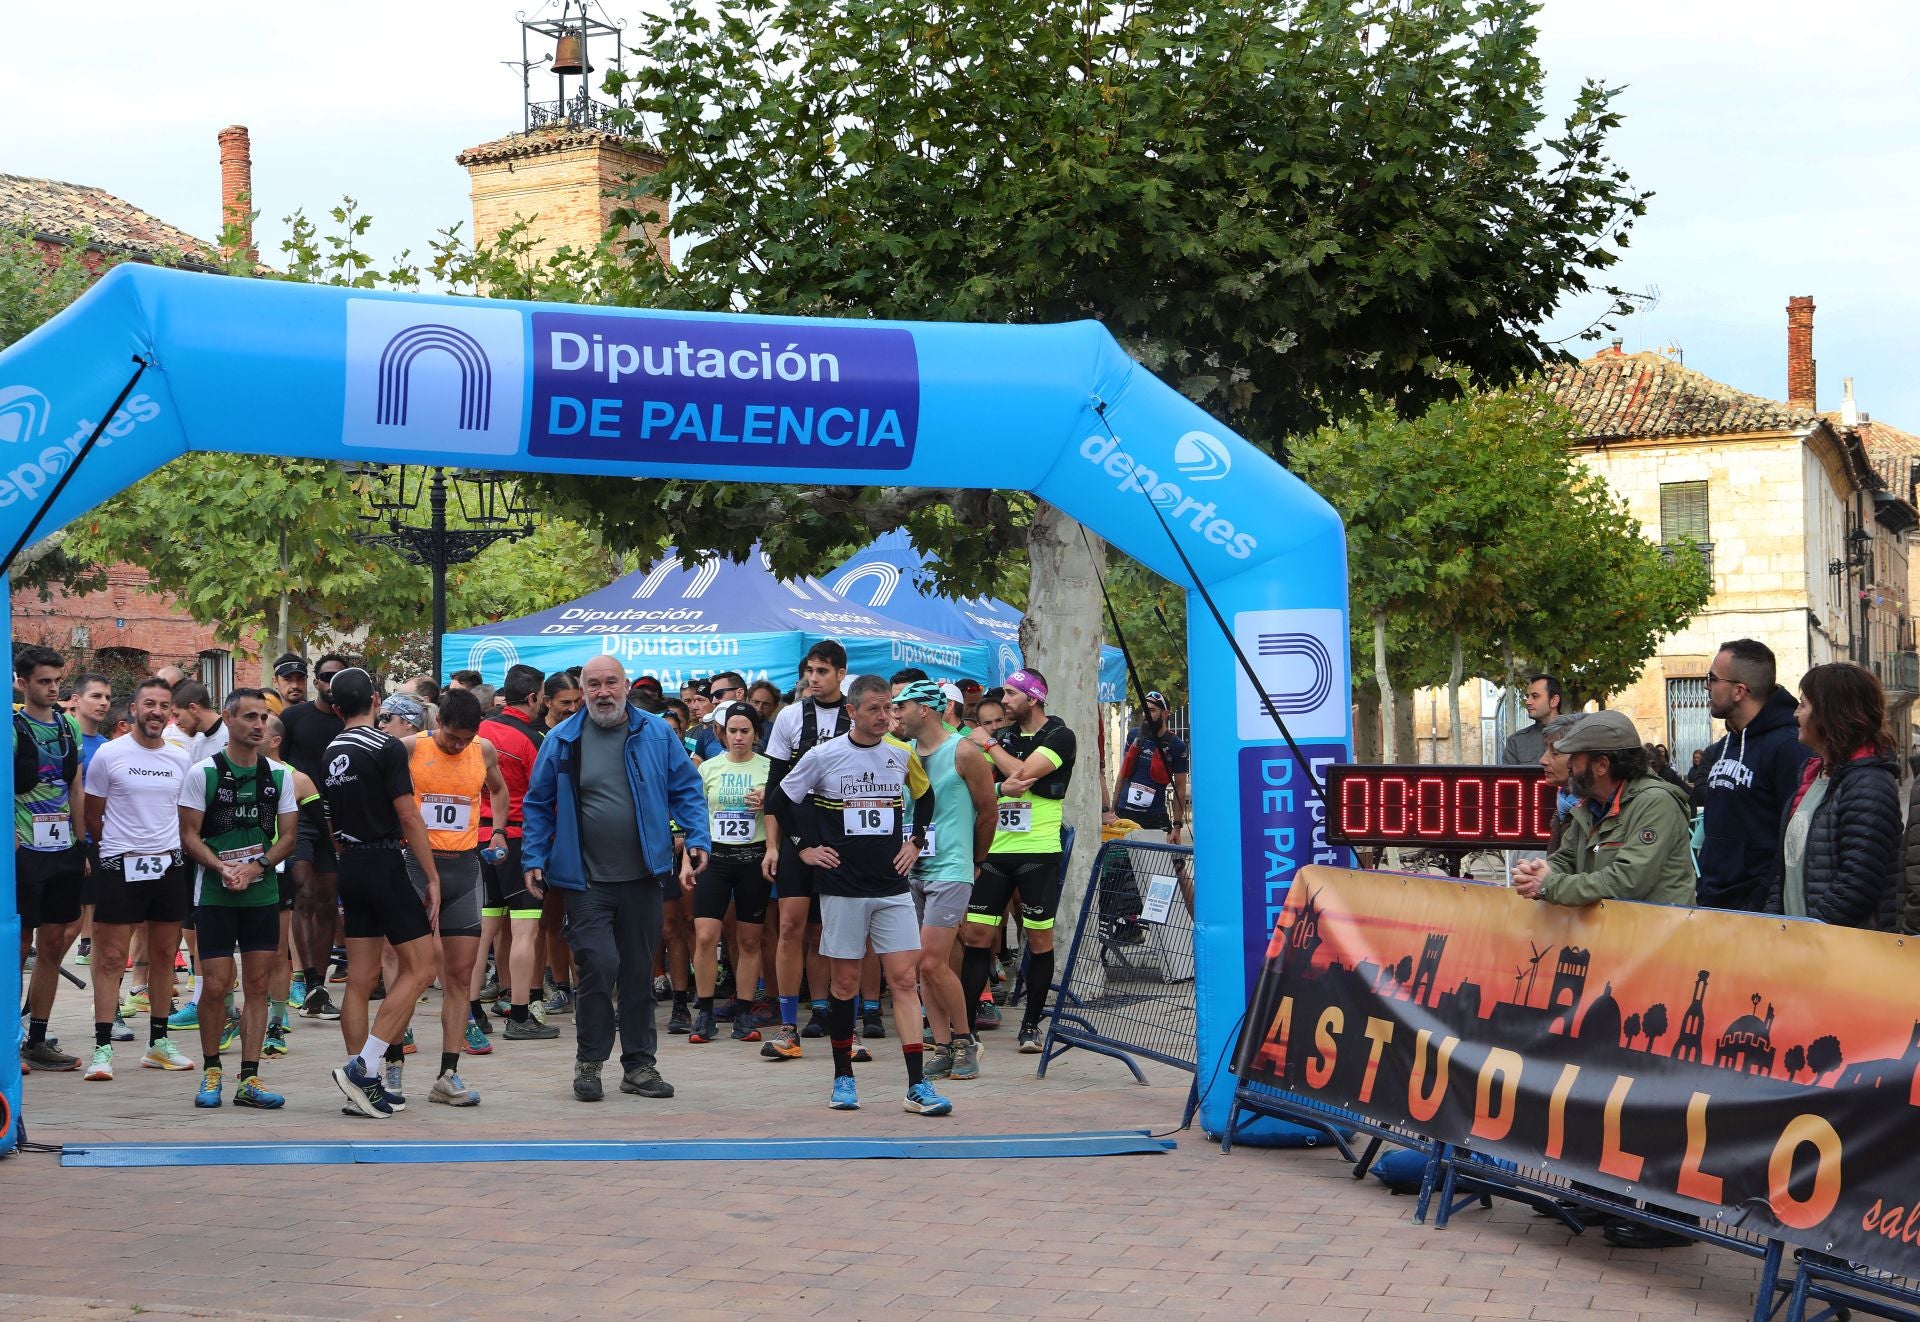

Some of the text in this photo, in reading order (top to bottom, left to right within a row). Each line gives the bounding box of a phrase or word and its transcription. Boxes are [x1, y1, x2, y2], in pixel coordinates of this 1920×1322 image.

[550, 331, 840, 384] Diputación
[547, 396, 905, 447] DE PALENCIA
[1079, 435, 1257, 560] deportes
[559, 608, 704, 623] Diputación
[540, 623, 719, 634] DE PALENCIA
[601, 634, 738, 661] Diputación
[891, 638, 961, 668] Diputación
[720, 773, 754, 787] TRAIL
[1261, 759, 1294, 814] DE
[718, 787, 744, 796] CIUDAD
[1133, 790, 1144, 801] 3
[434, 804, 457, 825] 10
[857, 809, 881, 829] 16
[999, 810, 1021, 827] 35
[48, 823, 60, 840] 4
[718, 820, 750, 837] 123
[134, 856, 163, 875] 43
[1292, 911, 1315, 950] de
[1249, 995, 1843, 1230] ASTUDILLO
[1862, 1198, 1920, 1247] sal
